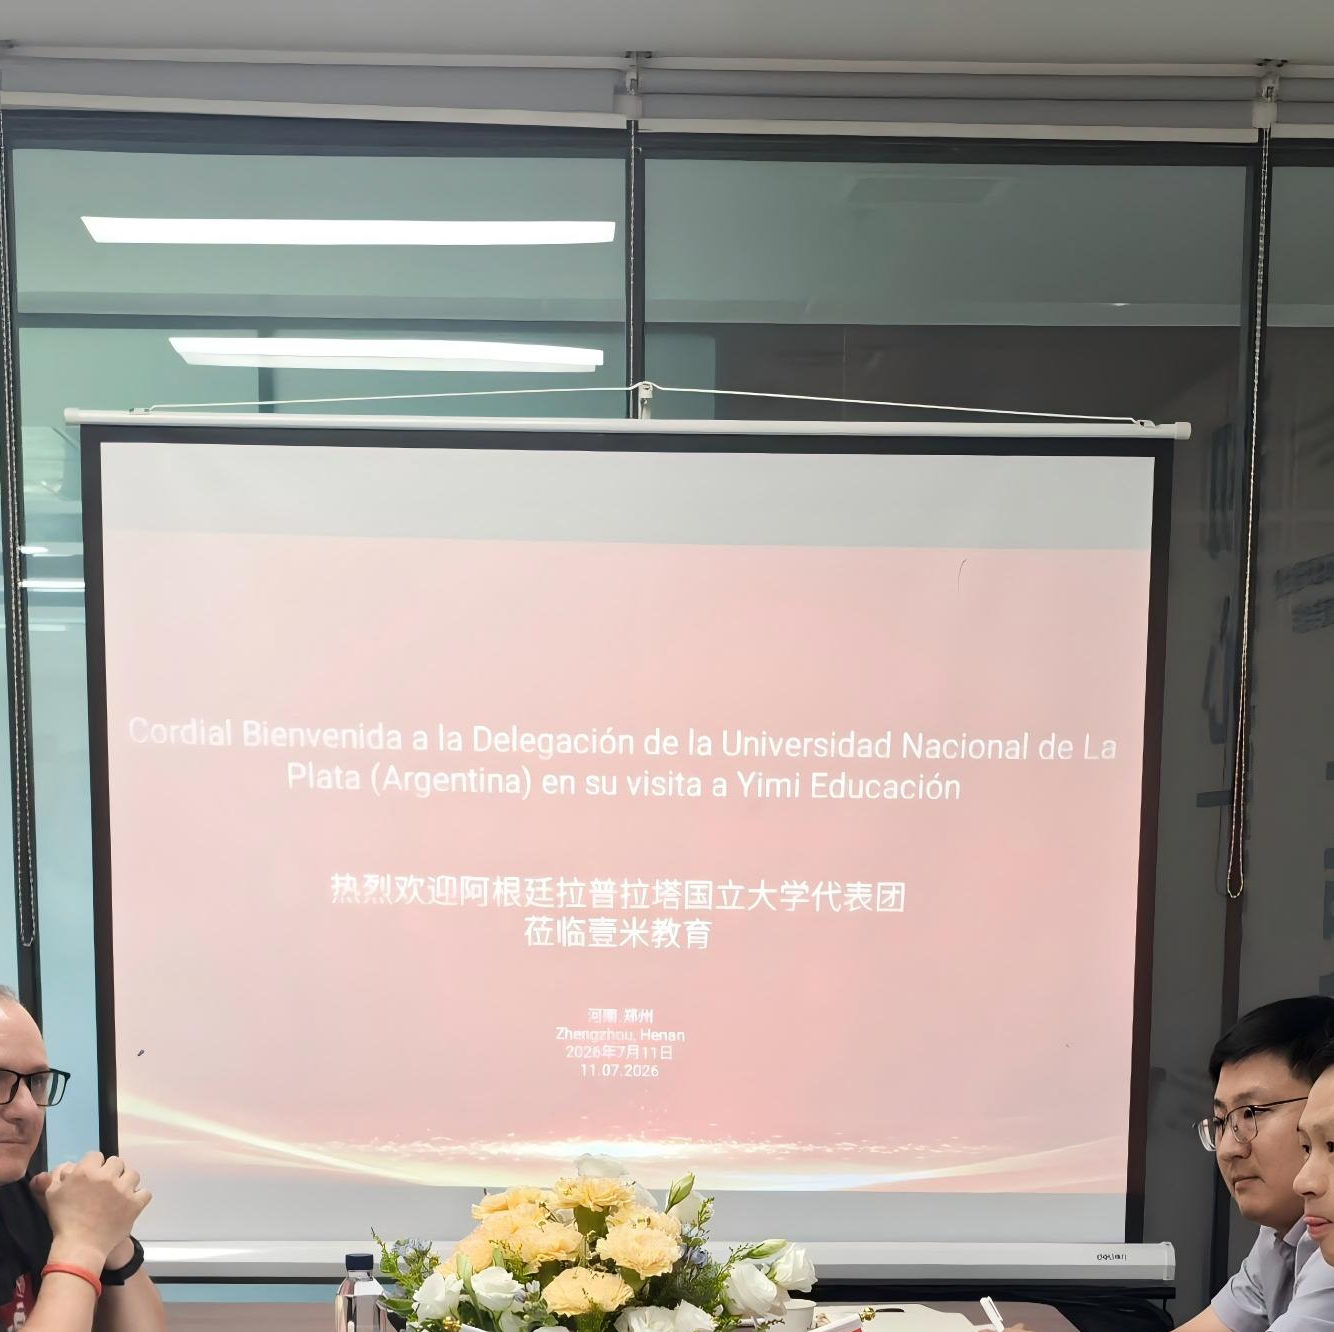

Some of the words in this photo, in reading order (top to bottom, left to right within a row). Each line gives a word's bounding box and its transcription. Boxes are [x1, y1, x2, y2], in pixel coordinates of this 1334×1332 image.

[128, 717, 232, 747] Cordial
[242, 720, 403, 752] Bienvenida
[411, 731, 429, 752] a
[438, 723, 464, 753] la
[472, 724, 635, 760] Delegación
[643, 728, 679, 756] de
[688, 728, 712, 756] la
[722, 729, 891, 759] Universidad
[902, 731, 1028, 760] Nacional
[1038, 732, 1074, 760] de
[1083, 733, 1117, 760] La
[286, 762, 361, 791] Plata
[370, 763, 532, 799] (Argentina)
[541, 773, 576, 795] en
[585, 773, 618, 796] su
[627, 770, 702, 798] visita
[711, 777, 728, 797] a
[737, 770, 800, 798] Yimi
[810, 772, 961, 800] Educación
[330, 872, 906, 914] 热烈欢迎阿根廷拉普拉塔国立大学代表团
[523, 914, 712, 950] 莅临壹米教育
[565, 1044, 673, 1060] 2026年7月11日
[640, 1028, 685, 1042] Henan
[580, 1063, 659, 1077] 11.07.2026
